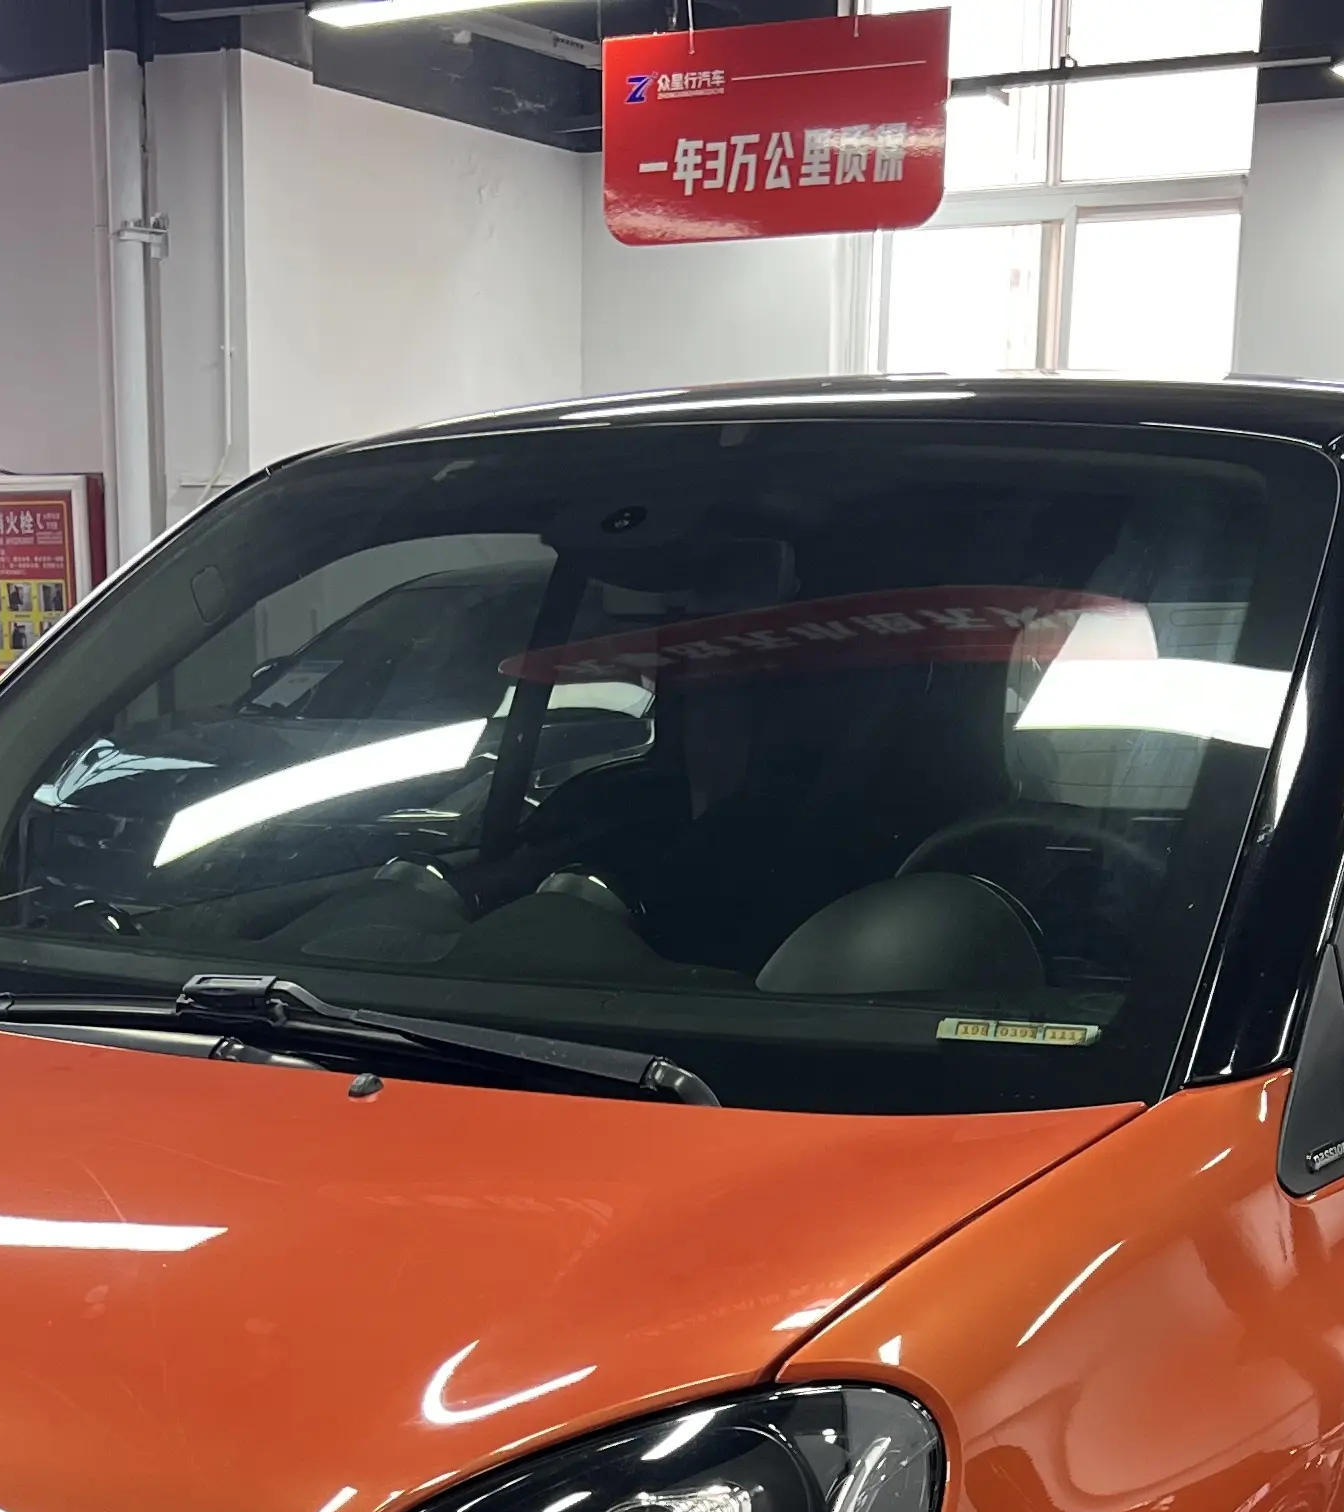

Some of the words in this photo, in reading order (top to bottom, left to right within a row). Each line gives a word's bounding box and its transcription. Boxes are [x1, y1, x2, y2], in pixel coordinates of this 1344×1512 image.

[657, 69, 725, 92] 众星行汽车
